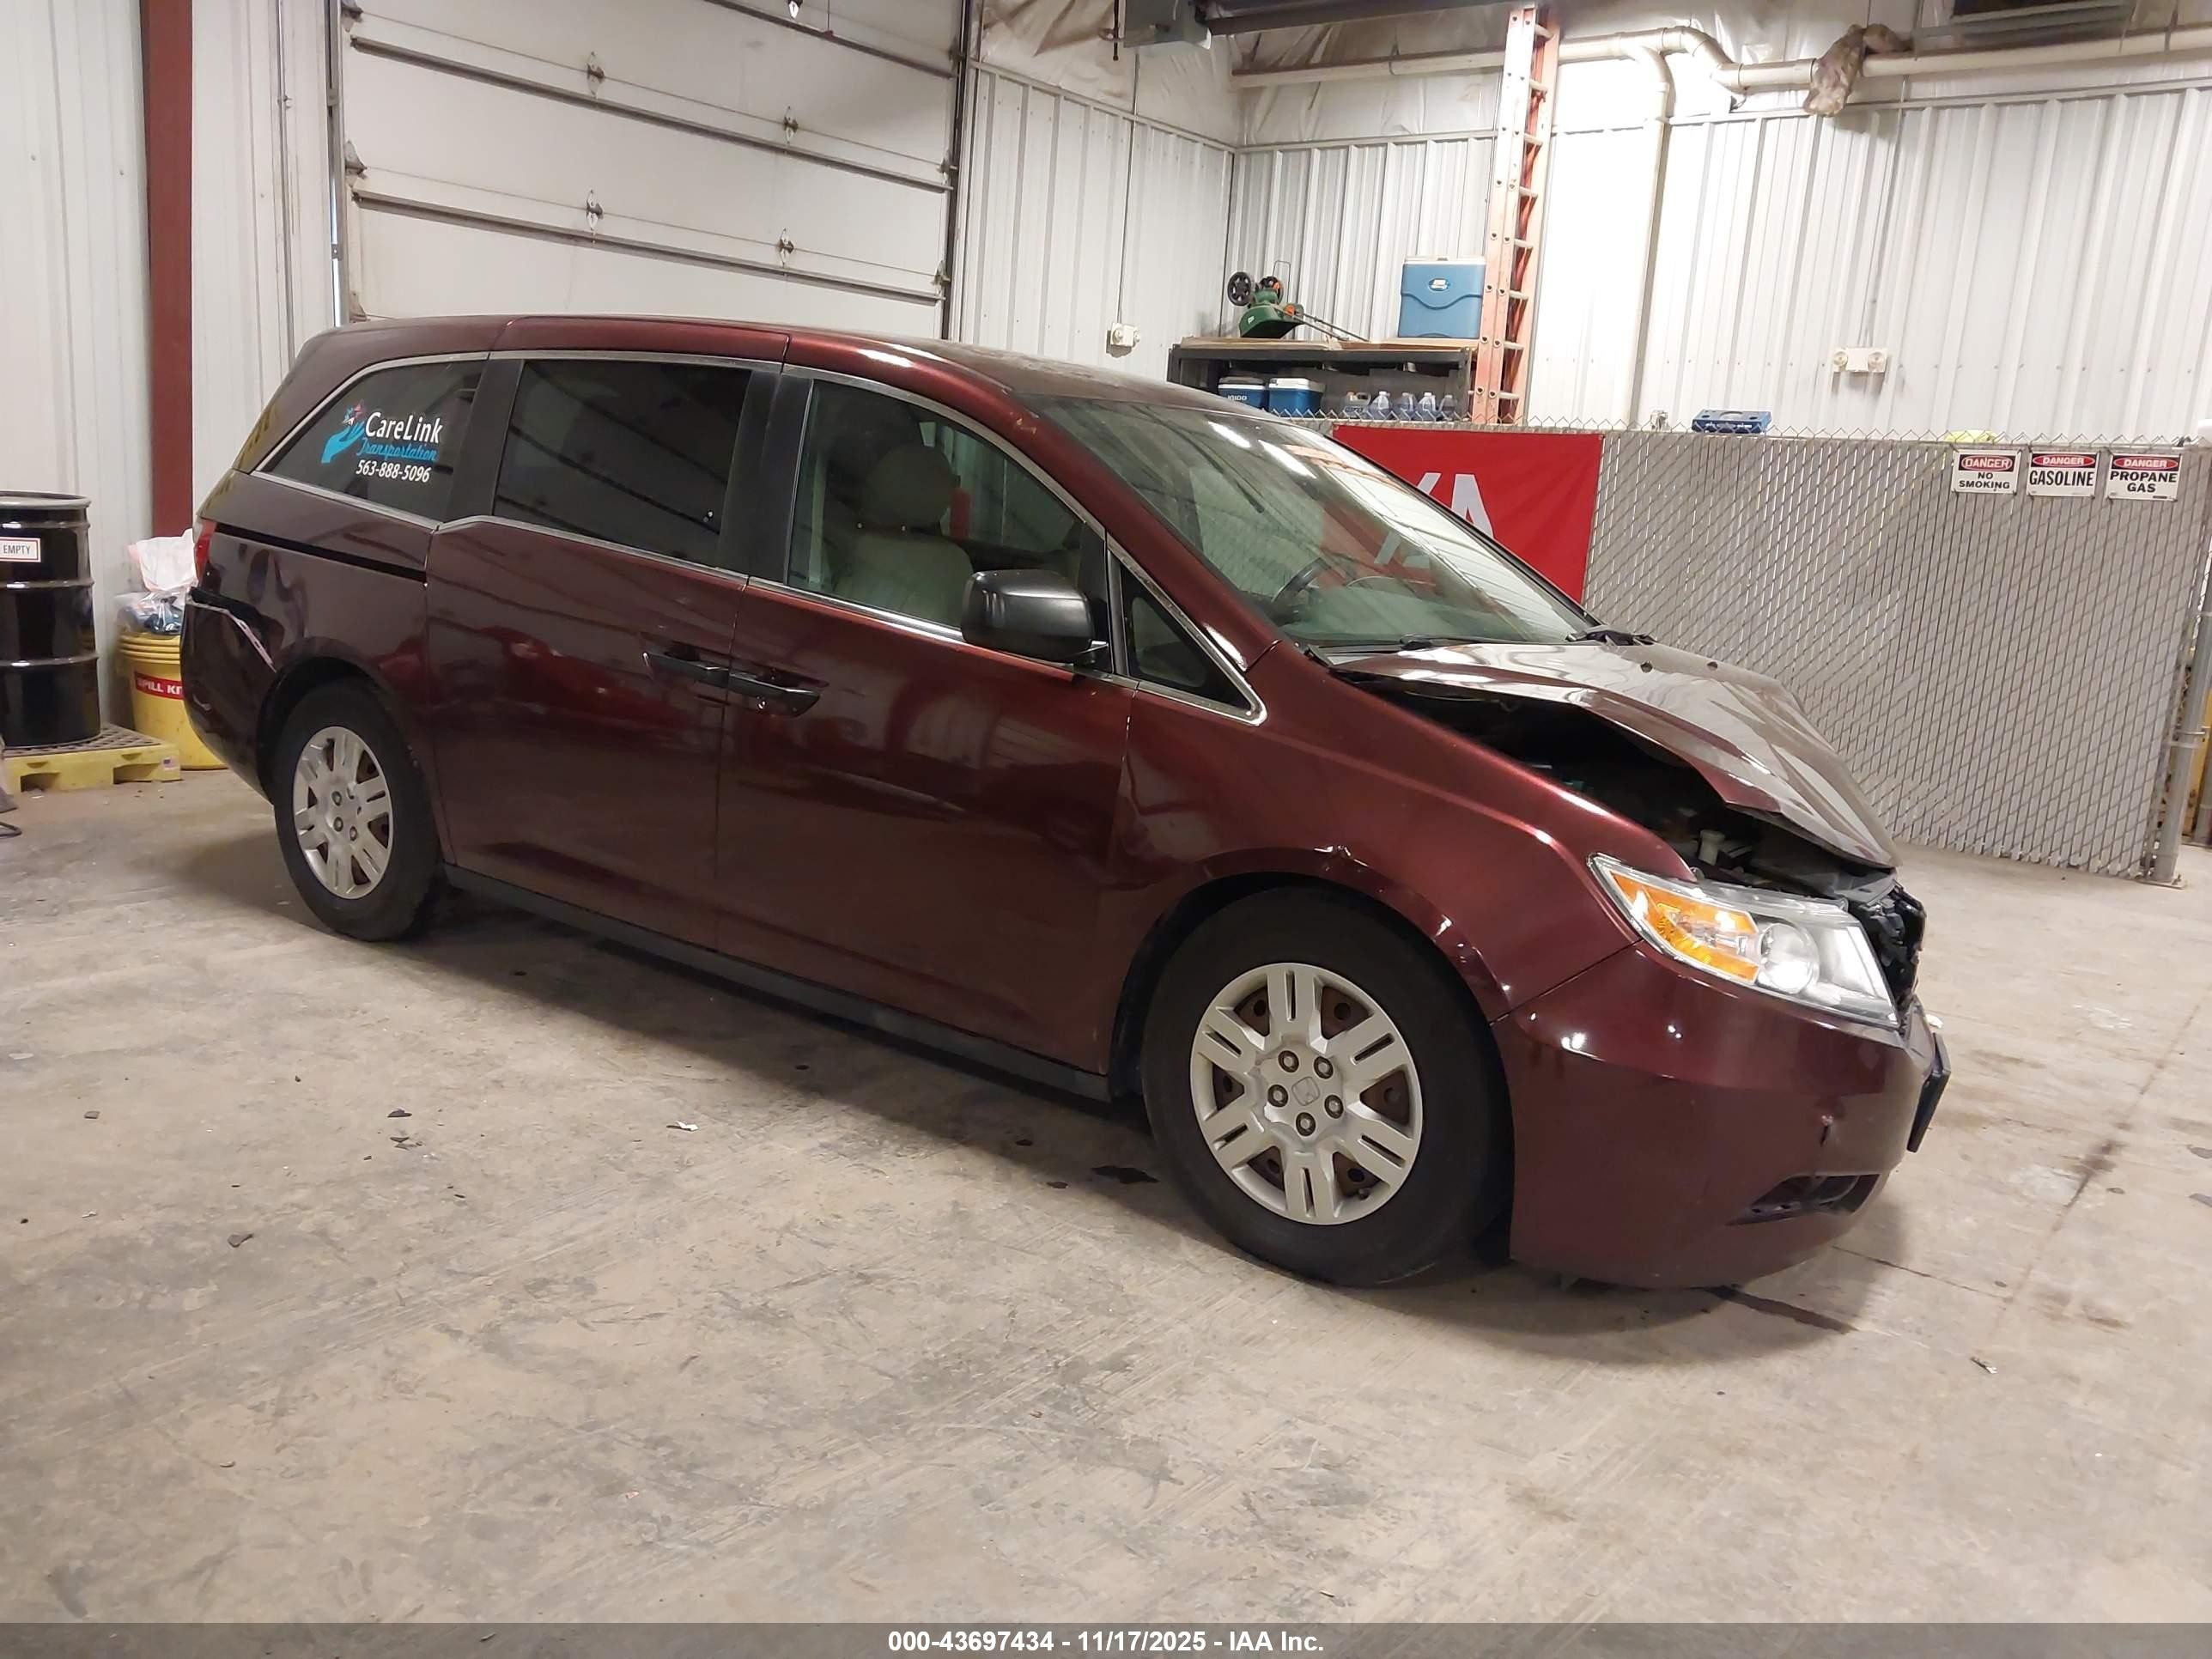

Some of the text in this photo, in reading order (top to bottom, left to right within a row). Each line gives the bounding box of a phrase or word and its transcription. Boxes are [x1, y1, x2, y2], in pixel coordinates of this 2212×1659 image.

[365, 411, 443, 443] CareLink
[356, 437, 438, 461] Transportation
[1965, 457, 2010, 469] DANGER
[2042, 456, 2084, 465] DANGER
[2124, 459, 2168, 467] DANGER
[356, 459, 431, 483] 563-888-5096
[2110, 471, 2178, 483] PROPANE
[2029, 470, 2094, 486] GASOLINE
[1959, 480, 2010, 489] SMOKING
[2127, 483, 2156, 493] GAS
[3, 544, 31, 556] EMPTY
